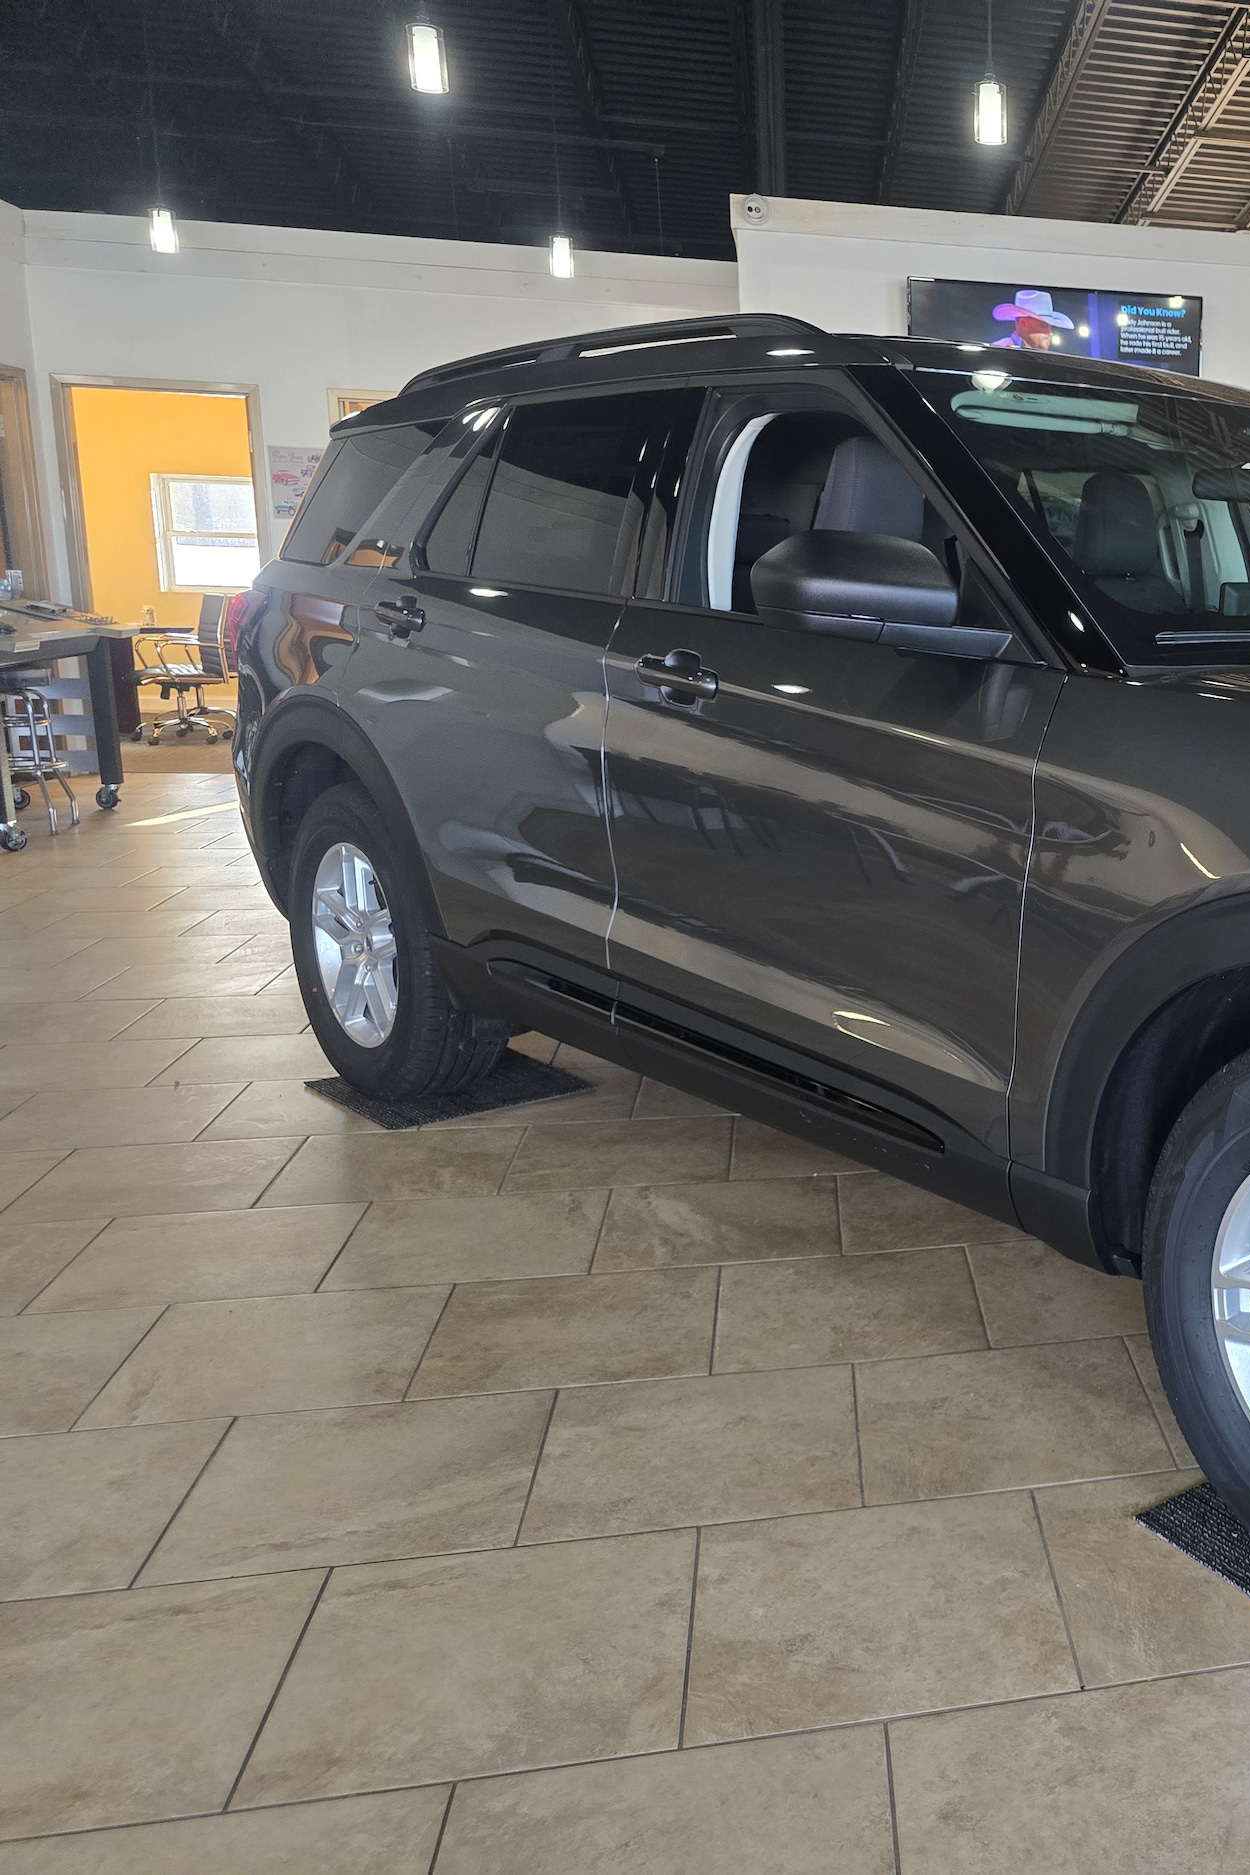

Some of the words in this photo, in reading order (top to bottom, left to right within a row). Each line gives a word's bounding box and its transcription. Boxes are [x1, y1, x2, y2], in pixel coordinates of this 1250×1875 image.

[1121, 305, 1136, 314] Did
[1137, 306, 1155, 316] You
[1156, 308, 1186, 318] Know?
